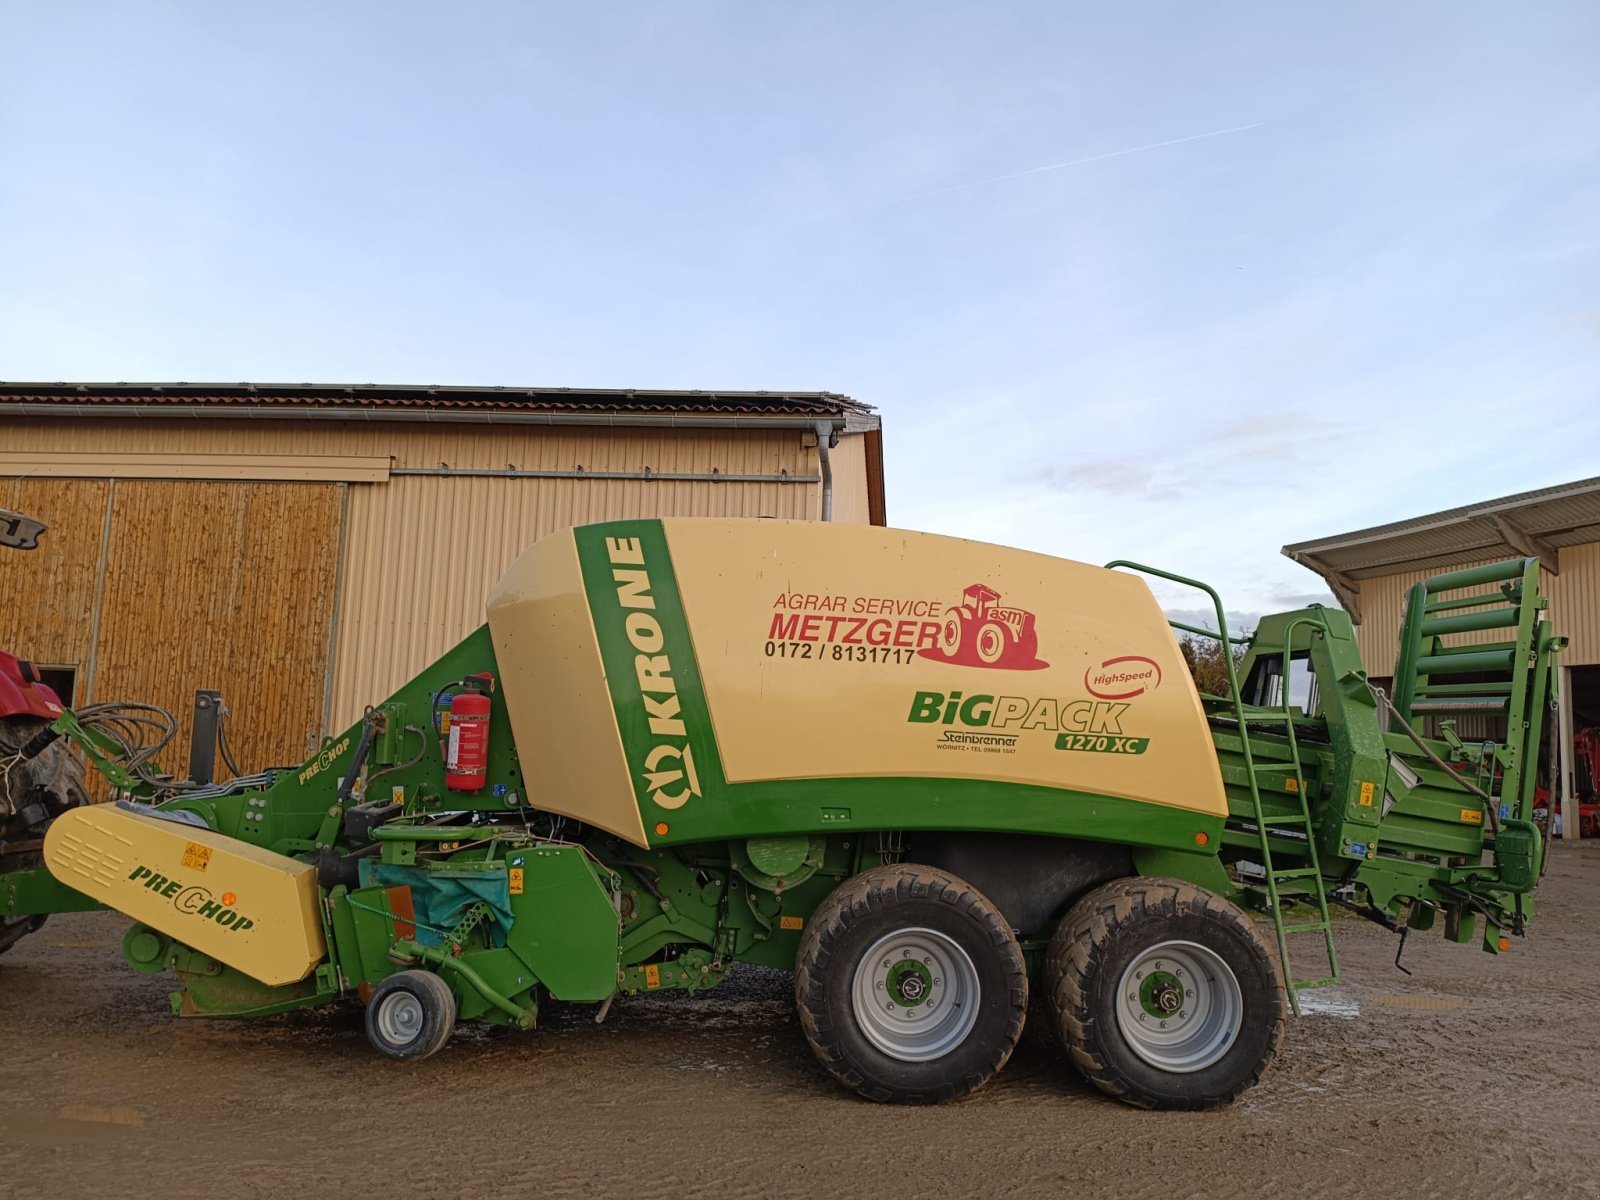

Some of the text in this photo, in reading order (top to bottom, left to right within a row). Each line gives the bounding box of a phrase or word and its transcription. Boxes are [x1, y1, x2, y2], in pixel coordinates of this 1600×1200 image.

[773, 593, 942, 617] AGRAR SERVICE
[990, 609, 1022, 625] asm
[605, 537, 687, 736] KRONE
[768, 613, 942, 648] METZGER
[765, 641, 915, 664] 0172 / 8131717
[1093, 670, 1153, 686] HighSpeed
[937, 730, 1019, 746] Steinbrenner
[1065, 735, 1140, 753] 1270 XC
